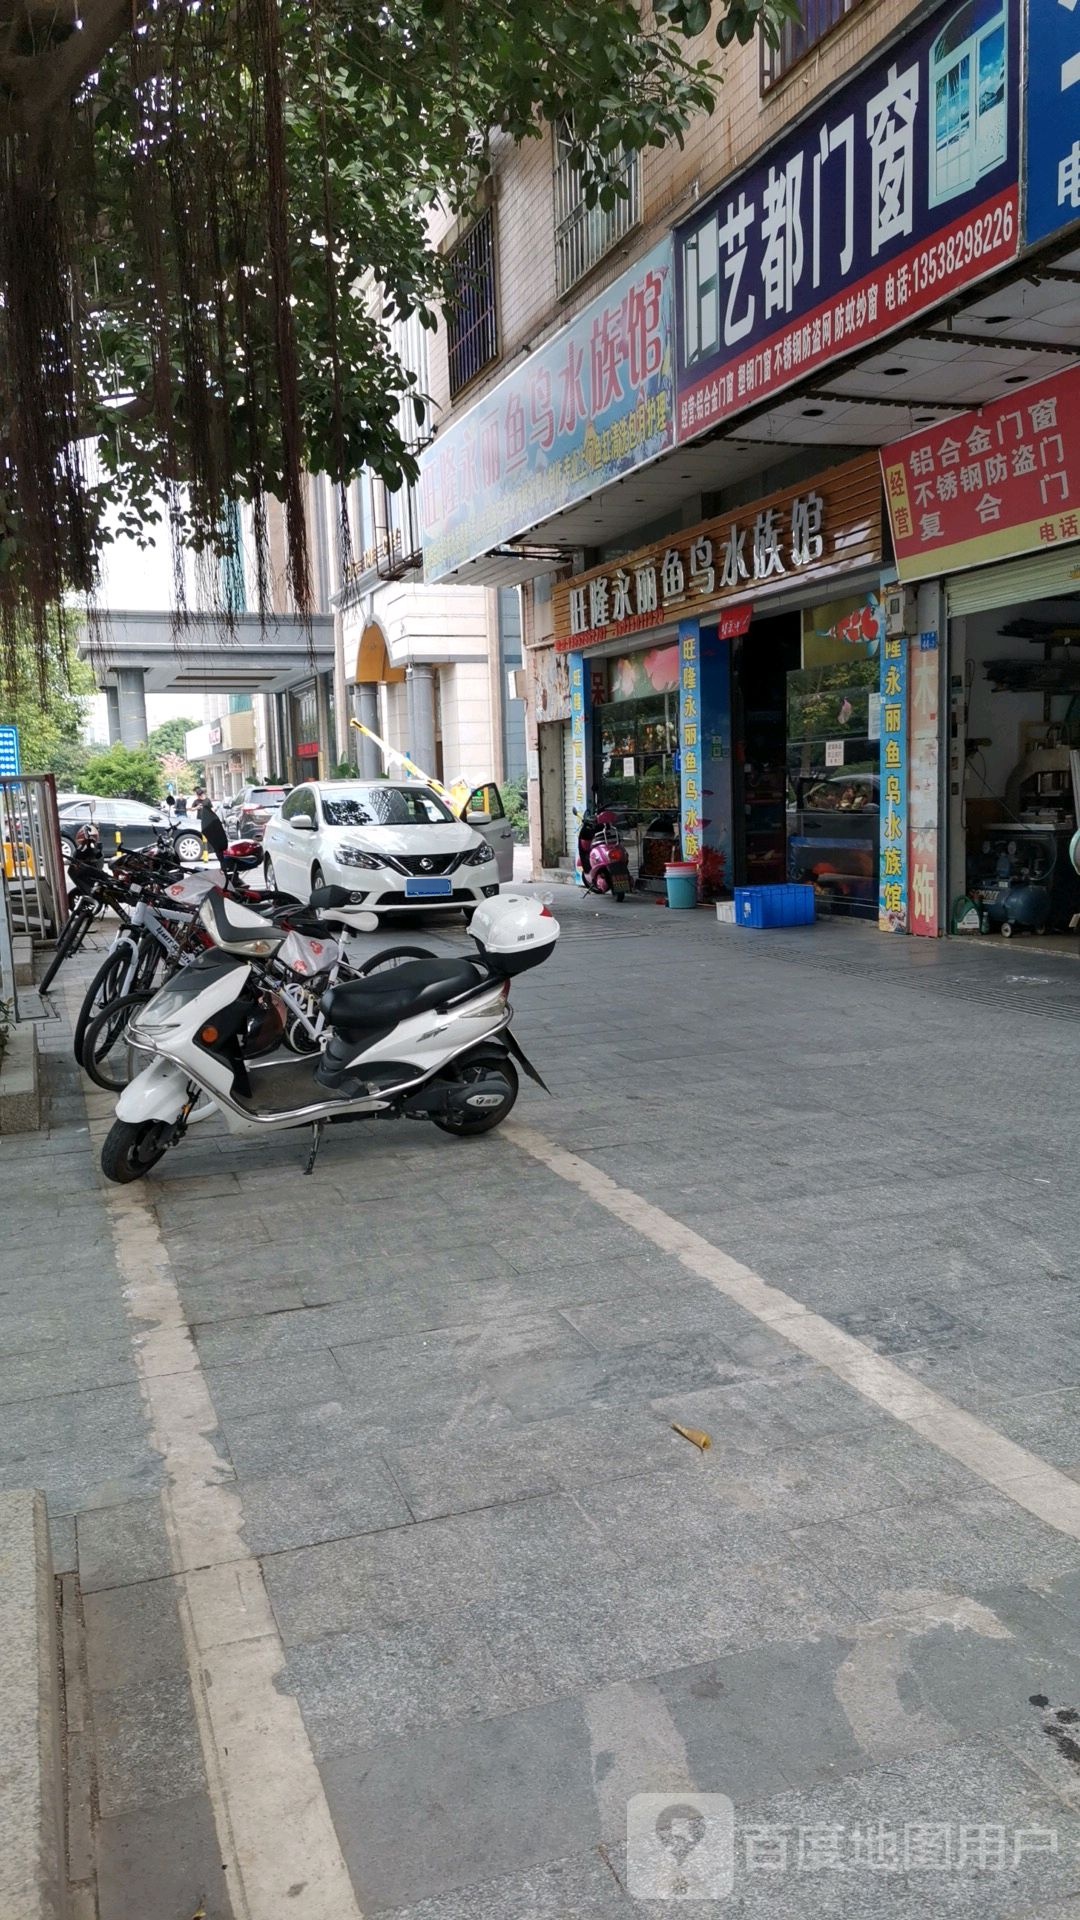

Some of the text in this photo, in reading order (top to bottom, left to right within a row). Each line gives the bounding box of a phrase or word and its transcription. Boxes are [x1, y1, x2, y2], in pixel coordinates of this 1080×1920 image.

[718, 62, 919, 347] 艺都门窗
[774, 310, 831, 375] 不锈钢防盗网
[909, 396, 1058, 478] 铝合金门窗
[913, 433, 1065, 509] 不锈钢防盗门
[889, 470, 910, 535] 经营
[1039, 514, 1079, 544] 电话
[569, 491, 823, 635] 旺隆永丽鱼鸟水族馆
[682, 638, 699, 856] 旺隆永丽鱼鸟水族
